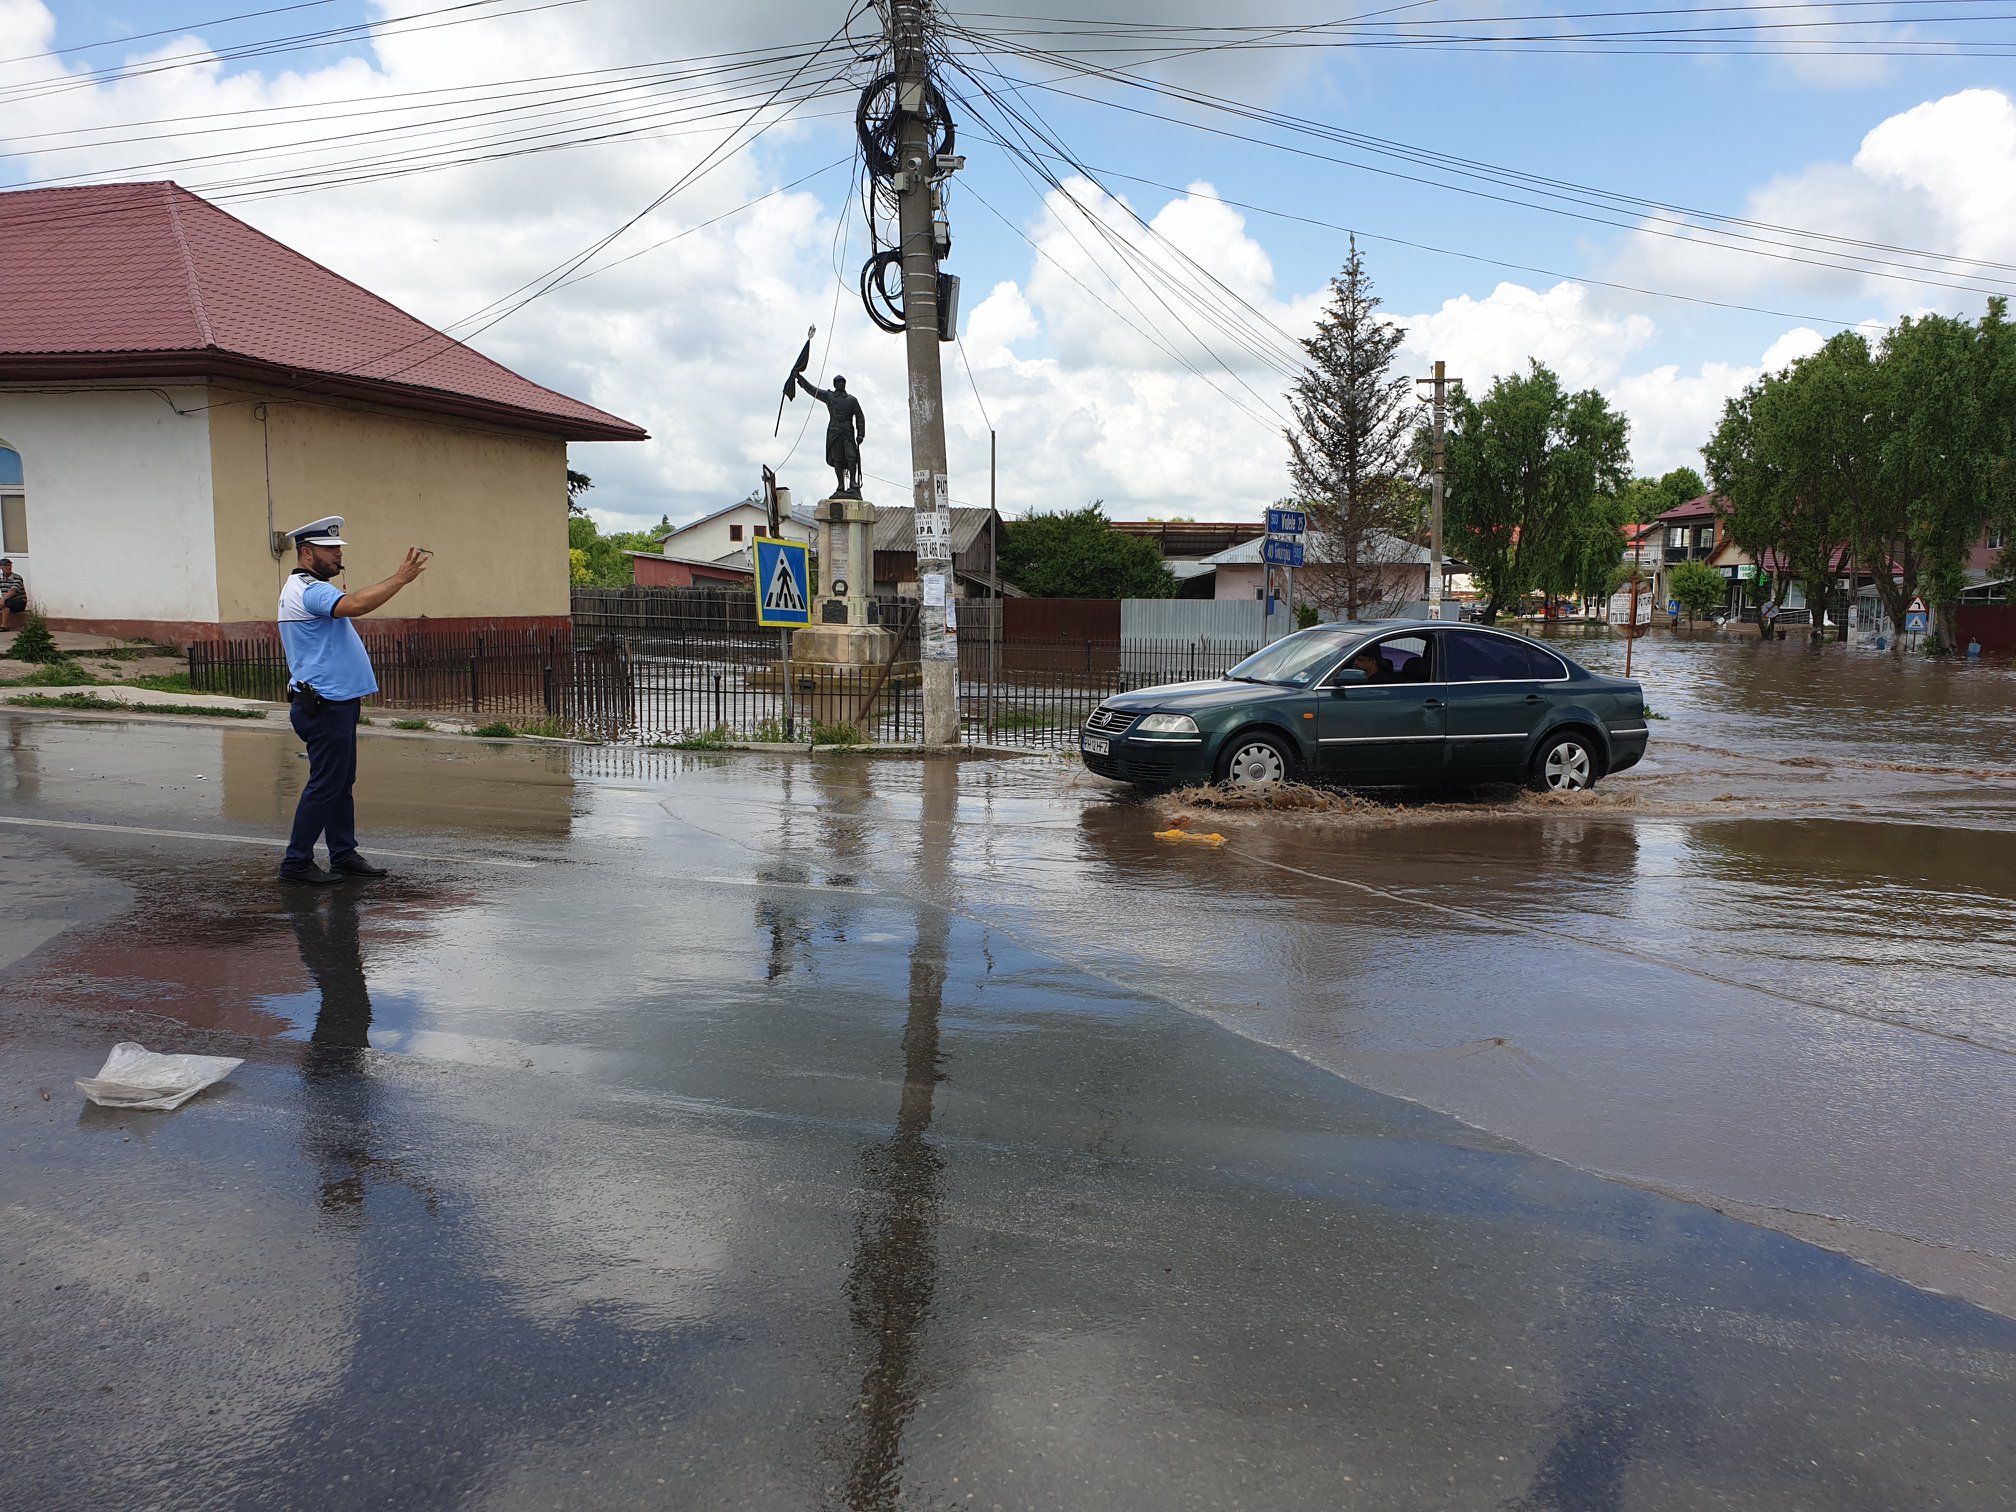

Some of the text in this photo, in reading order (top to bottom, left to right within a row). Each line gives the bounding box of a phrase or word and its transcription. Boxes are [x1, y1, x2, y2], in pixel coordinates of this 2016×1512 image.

[1281, 513, 1296, 531] Videle
[1298, 516, 1303, 531] 25
[1274, 542, 1290, 565] Giurgiu
